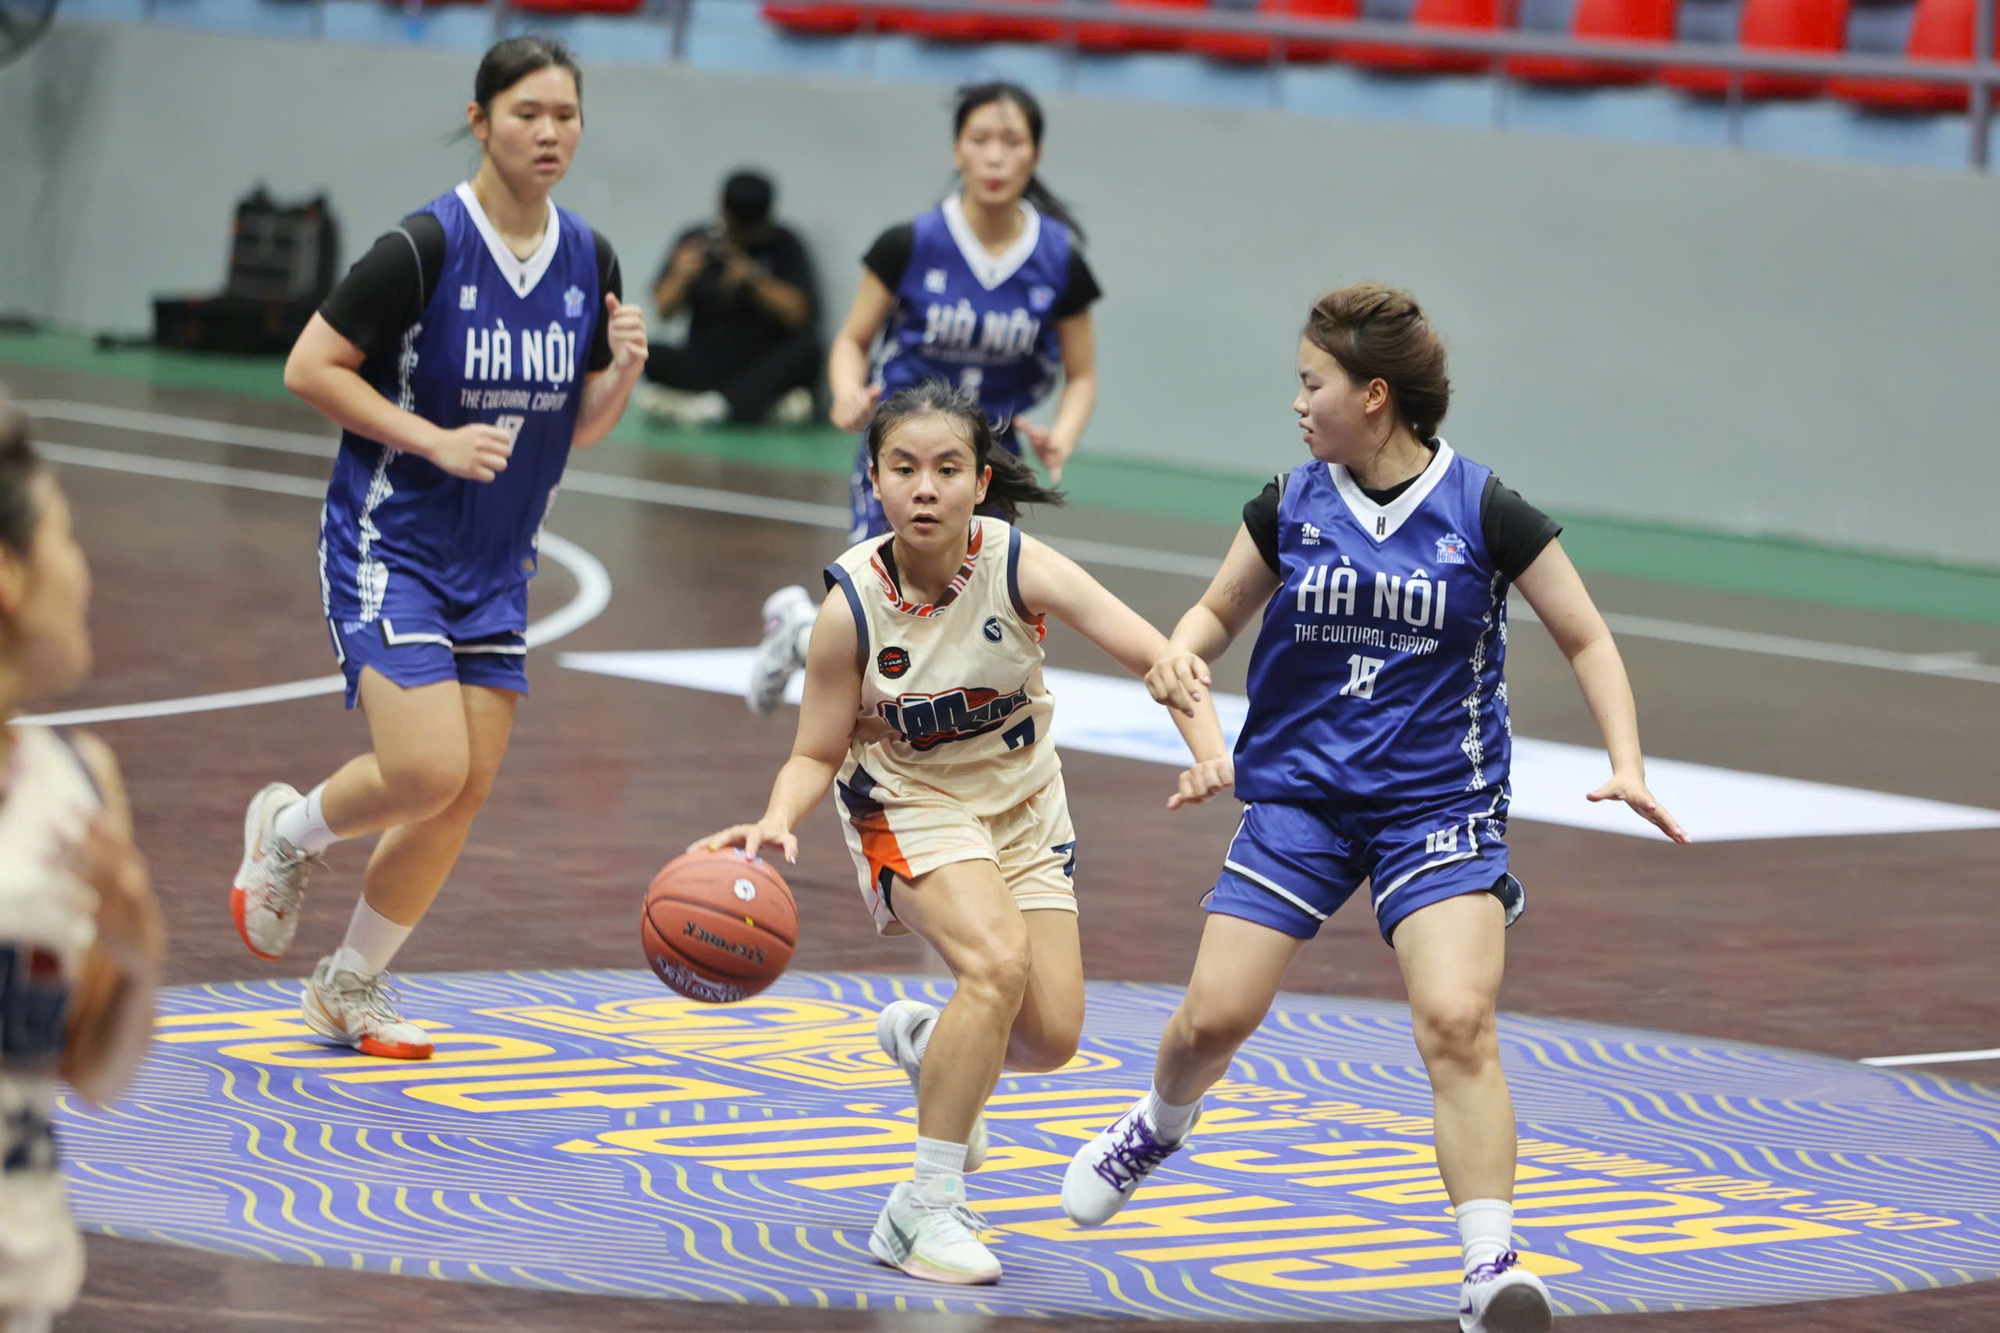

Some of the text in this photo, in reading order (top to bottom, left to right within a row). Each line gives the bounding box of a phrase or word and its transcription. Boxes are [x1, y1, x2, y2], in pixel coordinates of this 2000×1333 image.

[464, 318, 576, 391] HÀ NỘI
[460, 388, 482, 409] THE
[481, 389, 531, 410] CULTURAL
[1376, 516, 1386, 535] H
[1297, 555, 1447, 633] HÀ NỘI
[1294, 623, 1319, 643] THE
[1321, 625, 1386, 648] CULTURAL
[1339, 653, 1385, 700] 18
[1001, 715, 1036, 751] 7
[1188, 1140, 1863, 1255] BÓNG
[1648, 1175, 1817, 1201] ĐỘI
[1780, 1200, 1962, 1230] CÁC
